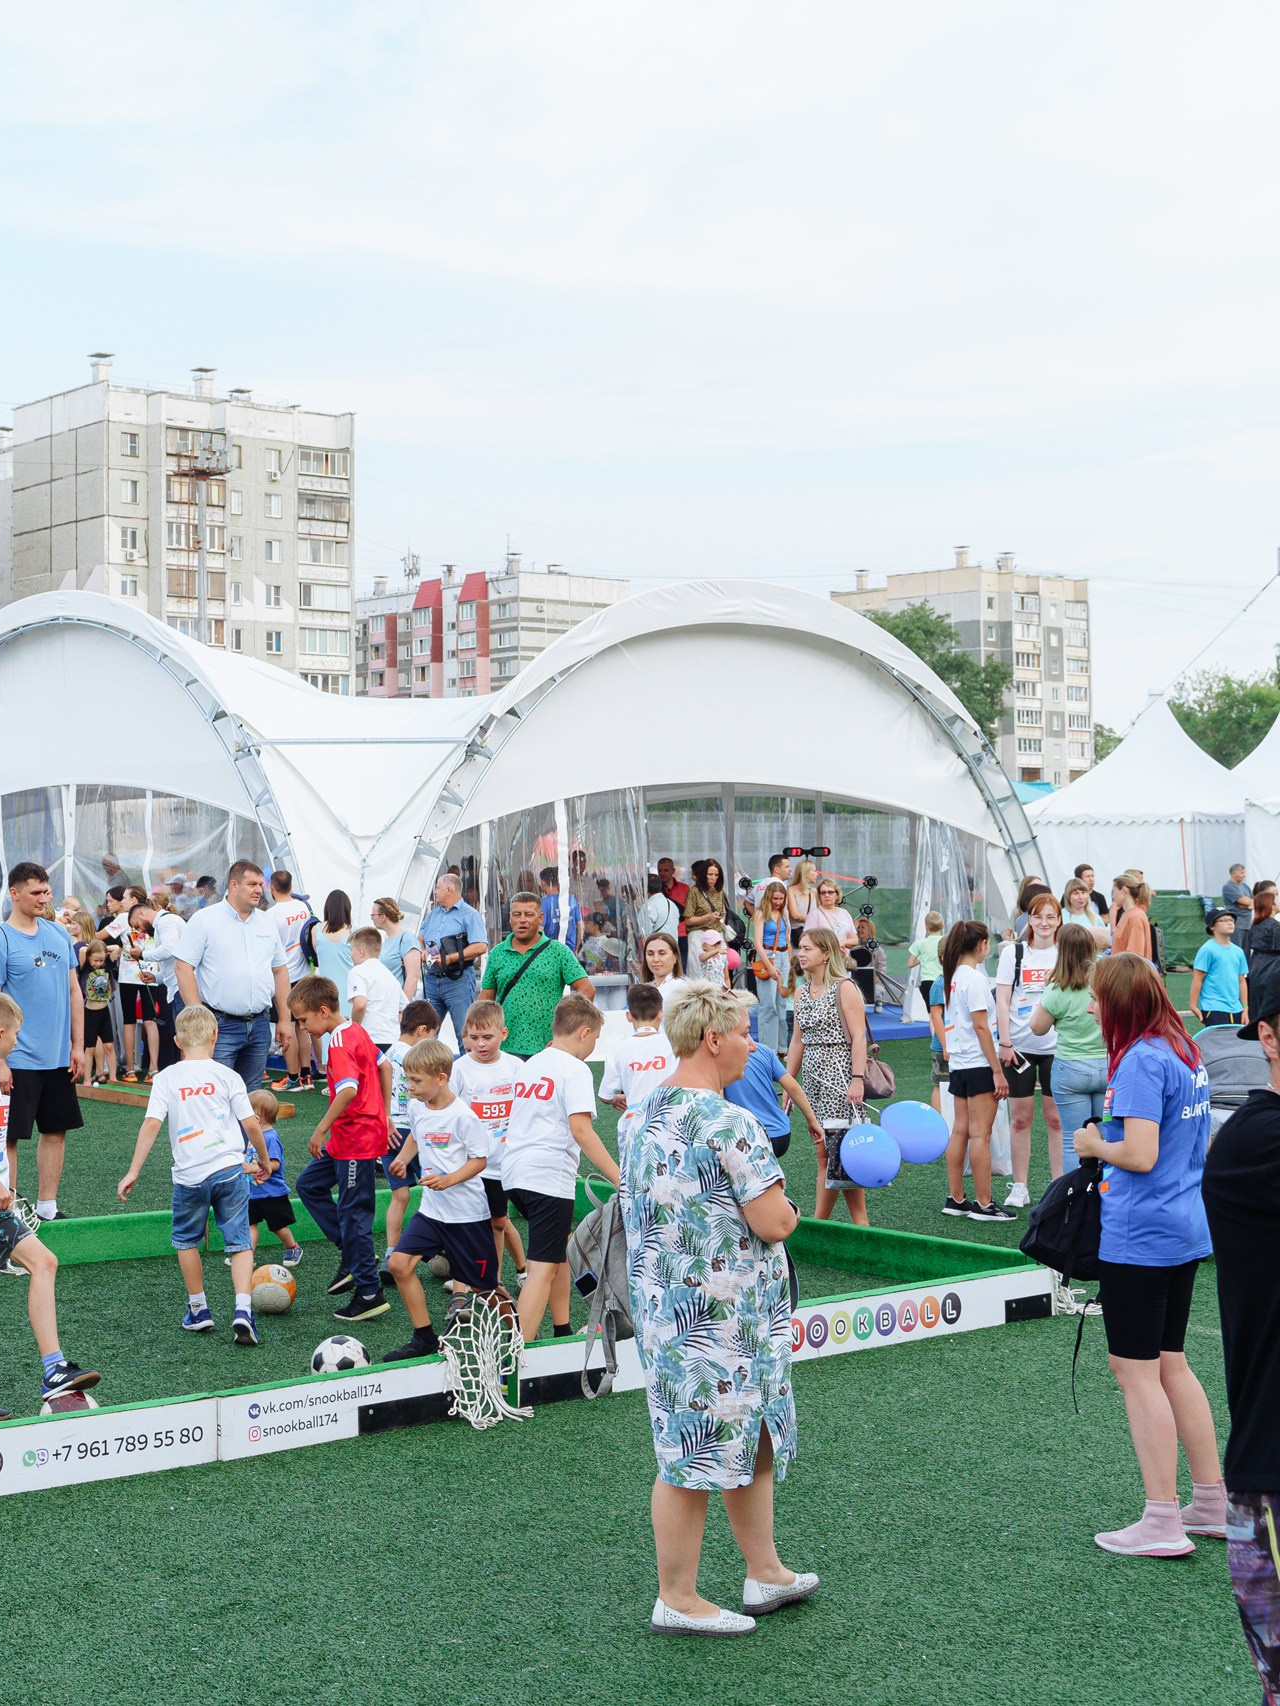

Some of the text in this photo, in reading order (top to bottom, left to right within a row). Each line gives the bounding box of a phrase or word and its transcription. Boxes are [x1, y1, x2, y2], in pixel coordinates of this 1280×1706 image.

[41, 950, 61, 962] POW!
[482, 1104, 507, 1117] 593
[348, 1160, 357, 1188] oma
[276, 1269, 288, 1278] 13
[475, 1260, 487, 1278] 7
[791, 1296, 959, 1346] NOOKBALL
[262, 1383, 383, 1415] vk.com/snookball174
[263, 1413, 339, 1437] snookball174
[52, 1426, 204, 1462] +7 961 789 55 80
